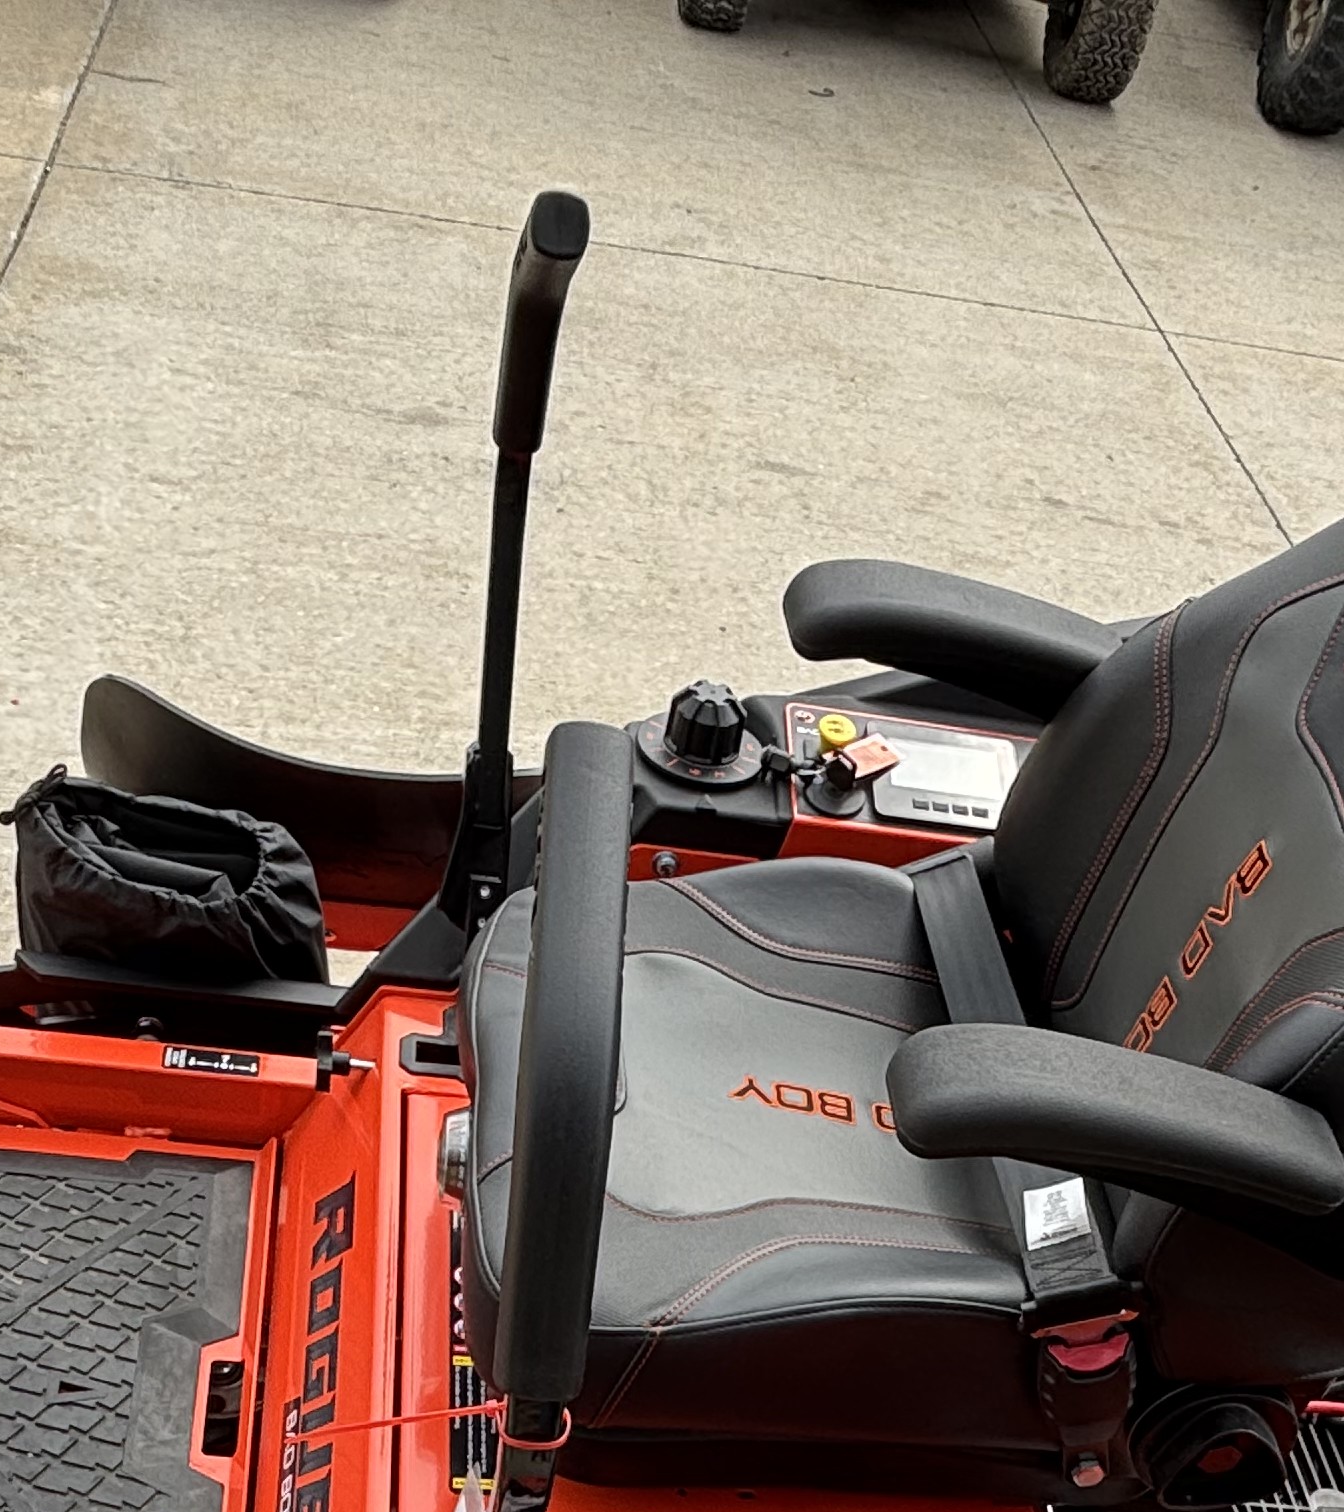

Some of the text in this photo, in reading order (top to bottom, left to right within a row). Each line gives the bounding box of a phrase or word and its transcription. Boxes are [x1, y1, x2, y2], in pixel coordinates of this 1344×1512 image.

[1122, 839, 1273, 1053] BAD BO
[728, 1074, 856, 1127] BOY
